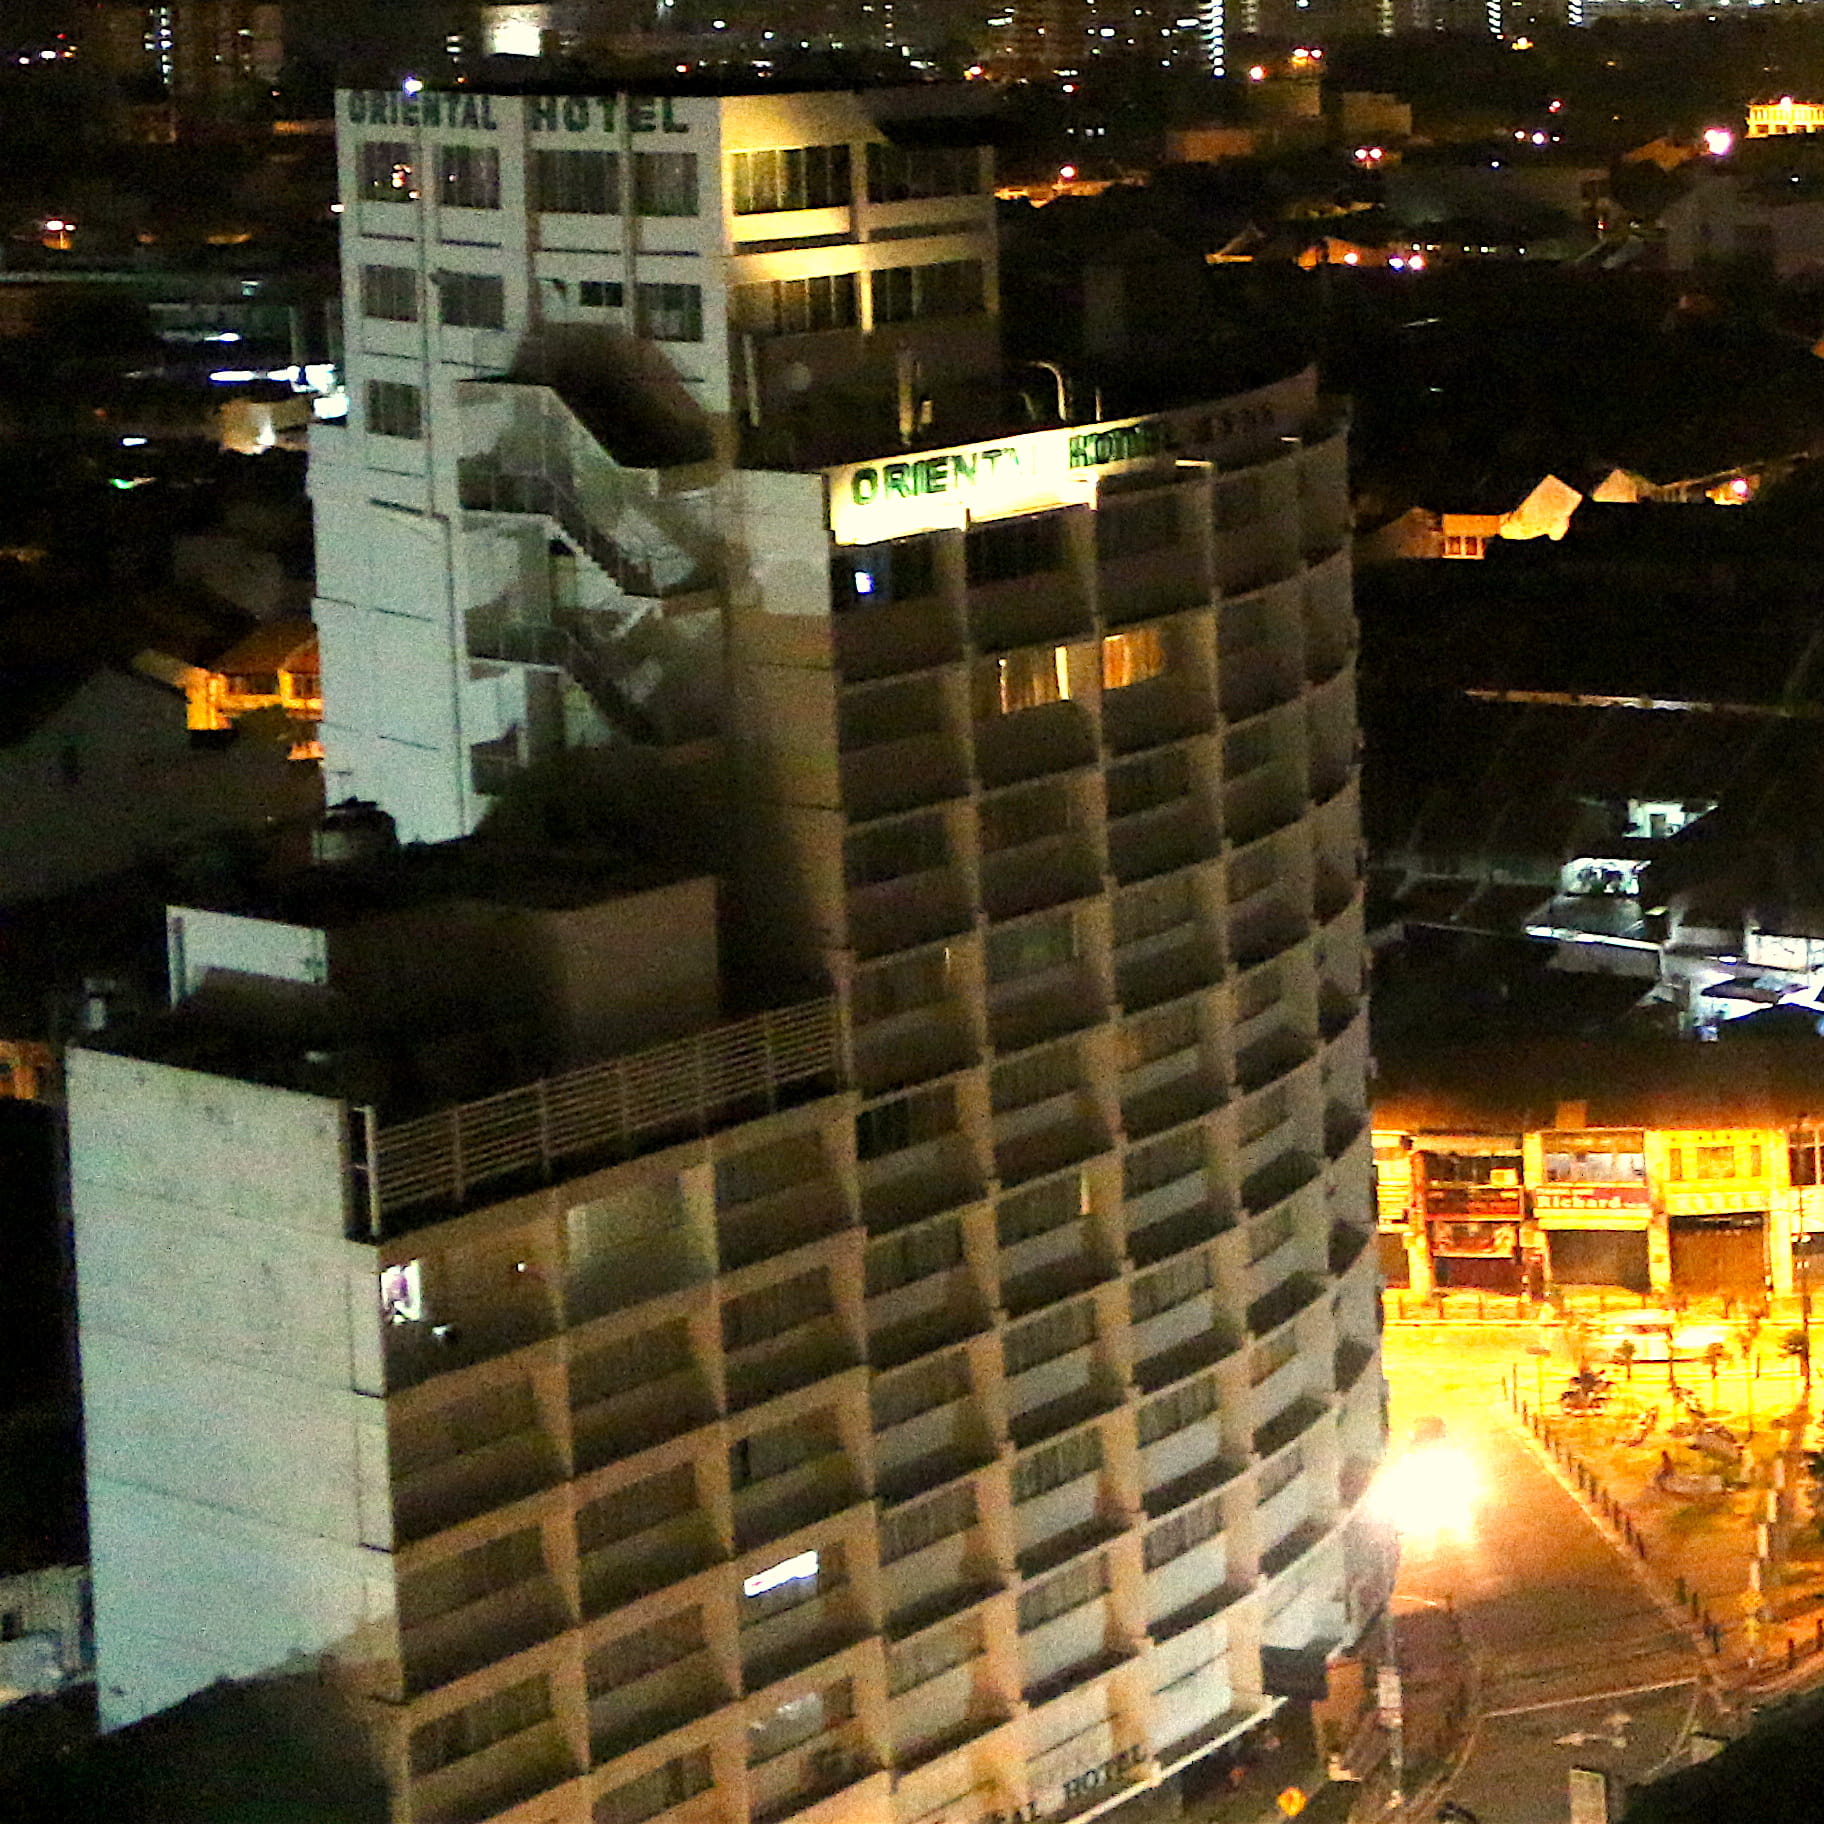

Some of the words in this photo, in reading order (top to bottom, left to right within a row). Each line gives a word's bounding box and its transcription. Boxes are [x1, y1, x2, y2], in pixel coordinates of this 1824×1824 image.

[350, 89, 497, 130] ORIENTAL
[525, 94, 688, 133] HOTEL
[852, 445, 1037, 505] ORIENTA
[1537, 1195, 1621, 1208] Richard
